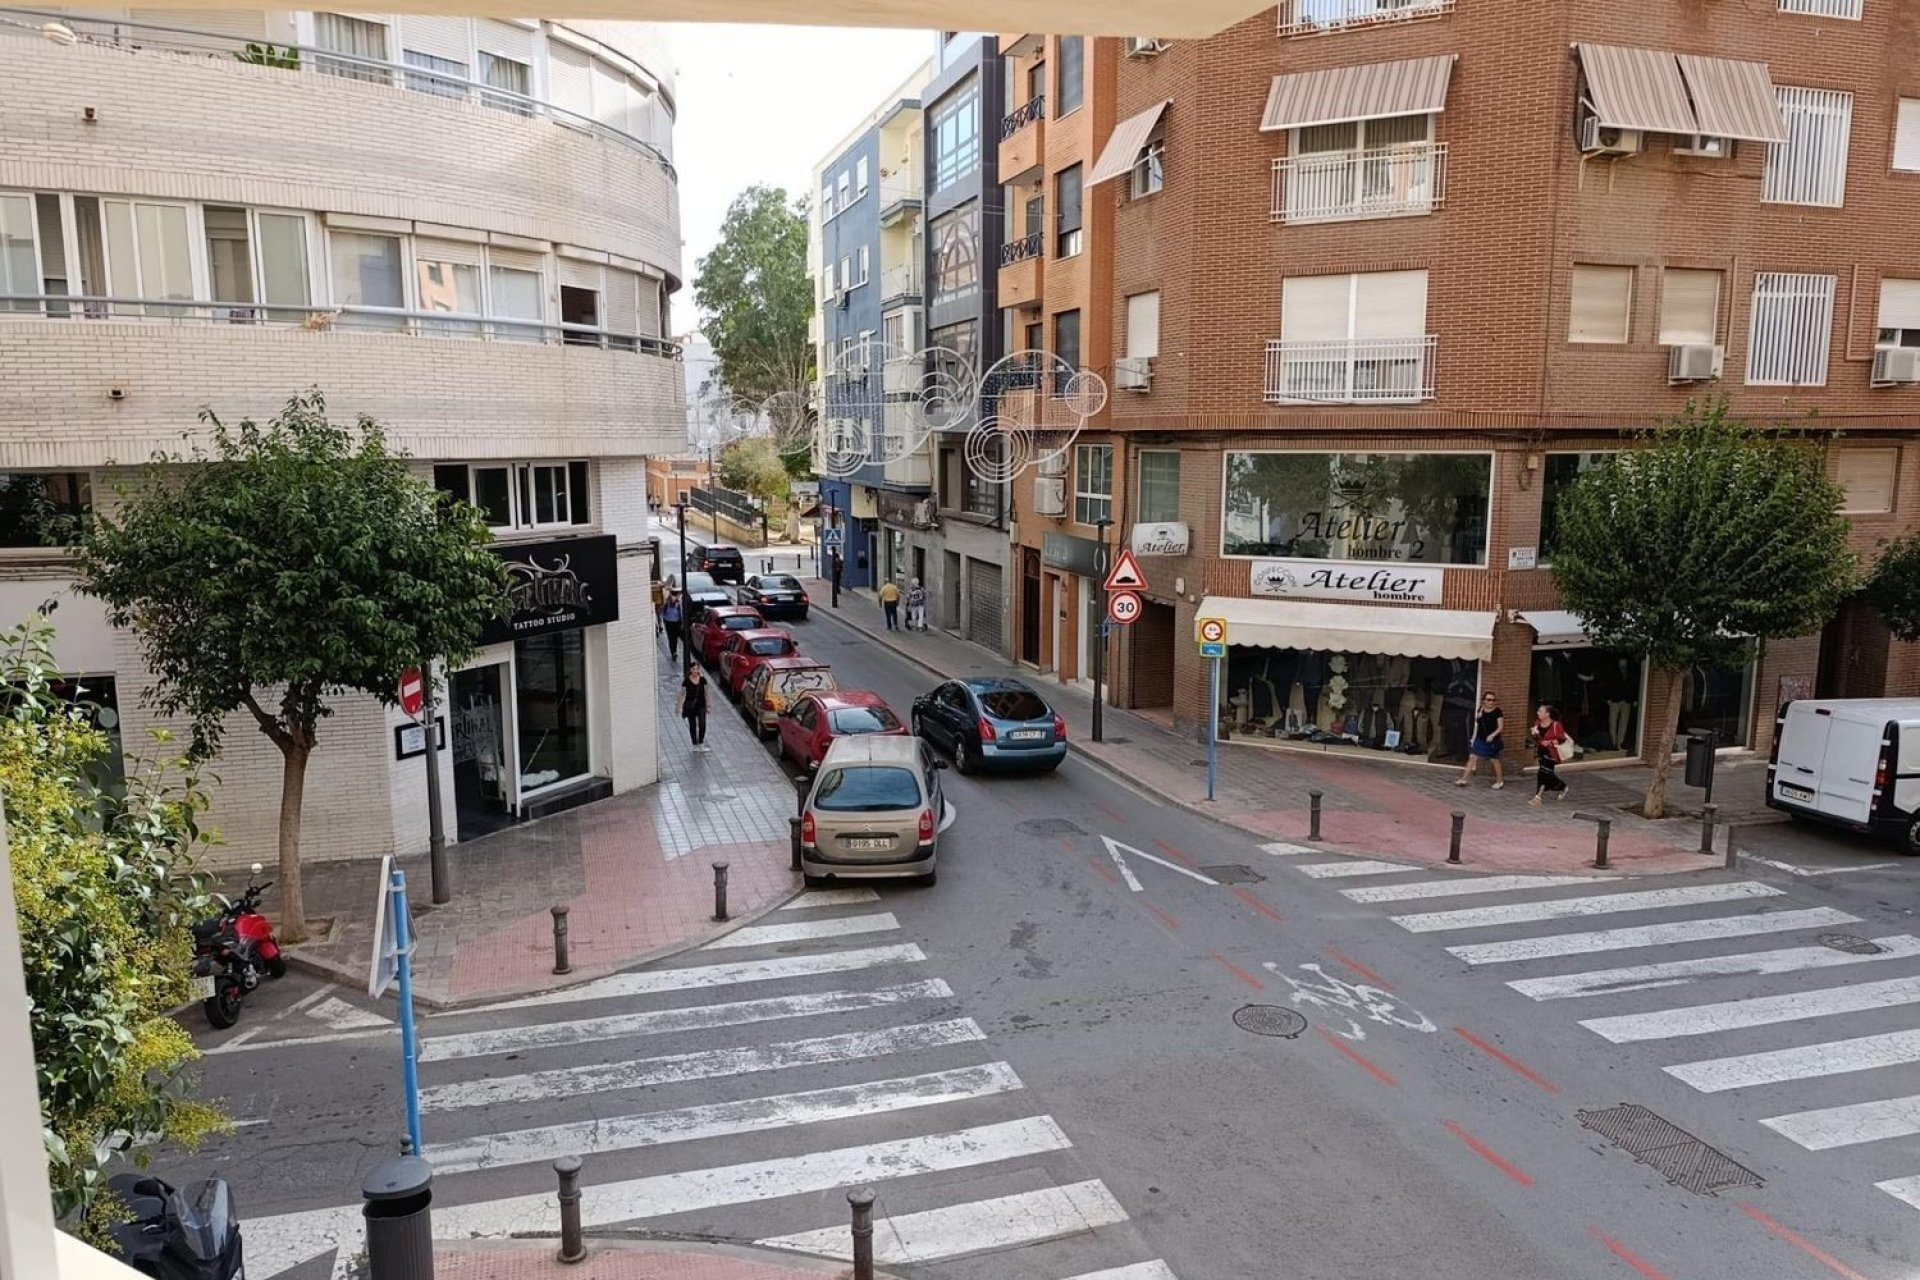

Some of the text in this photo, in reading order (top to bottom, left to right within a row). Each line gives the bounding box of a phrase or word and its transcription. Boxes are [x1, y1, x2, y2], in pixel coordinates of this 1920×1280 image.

[1296, 511, 1405, 542] Atelier
[1348, 540, 1425, 559] hombre 2
[1303, 569, 1426, 593] Atelier
[1374, 591, 1425, 601] hombre
[1117, 602, 1135, 613] 30
[513, 613, 576, 631] TATTOO STUDIO
